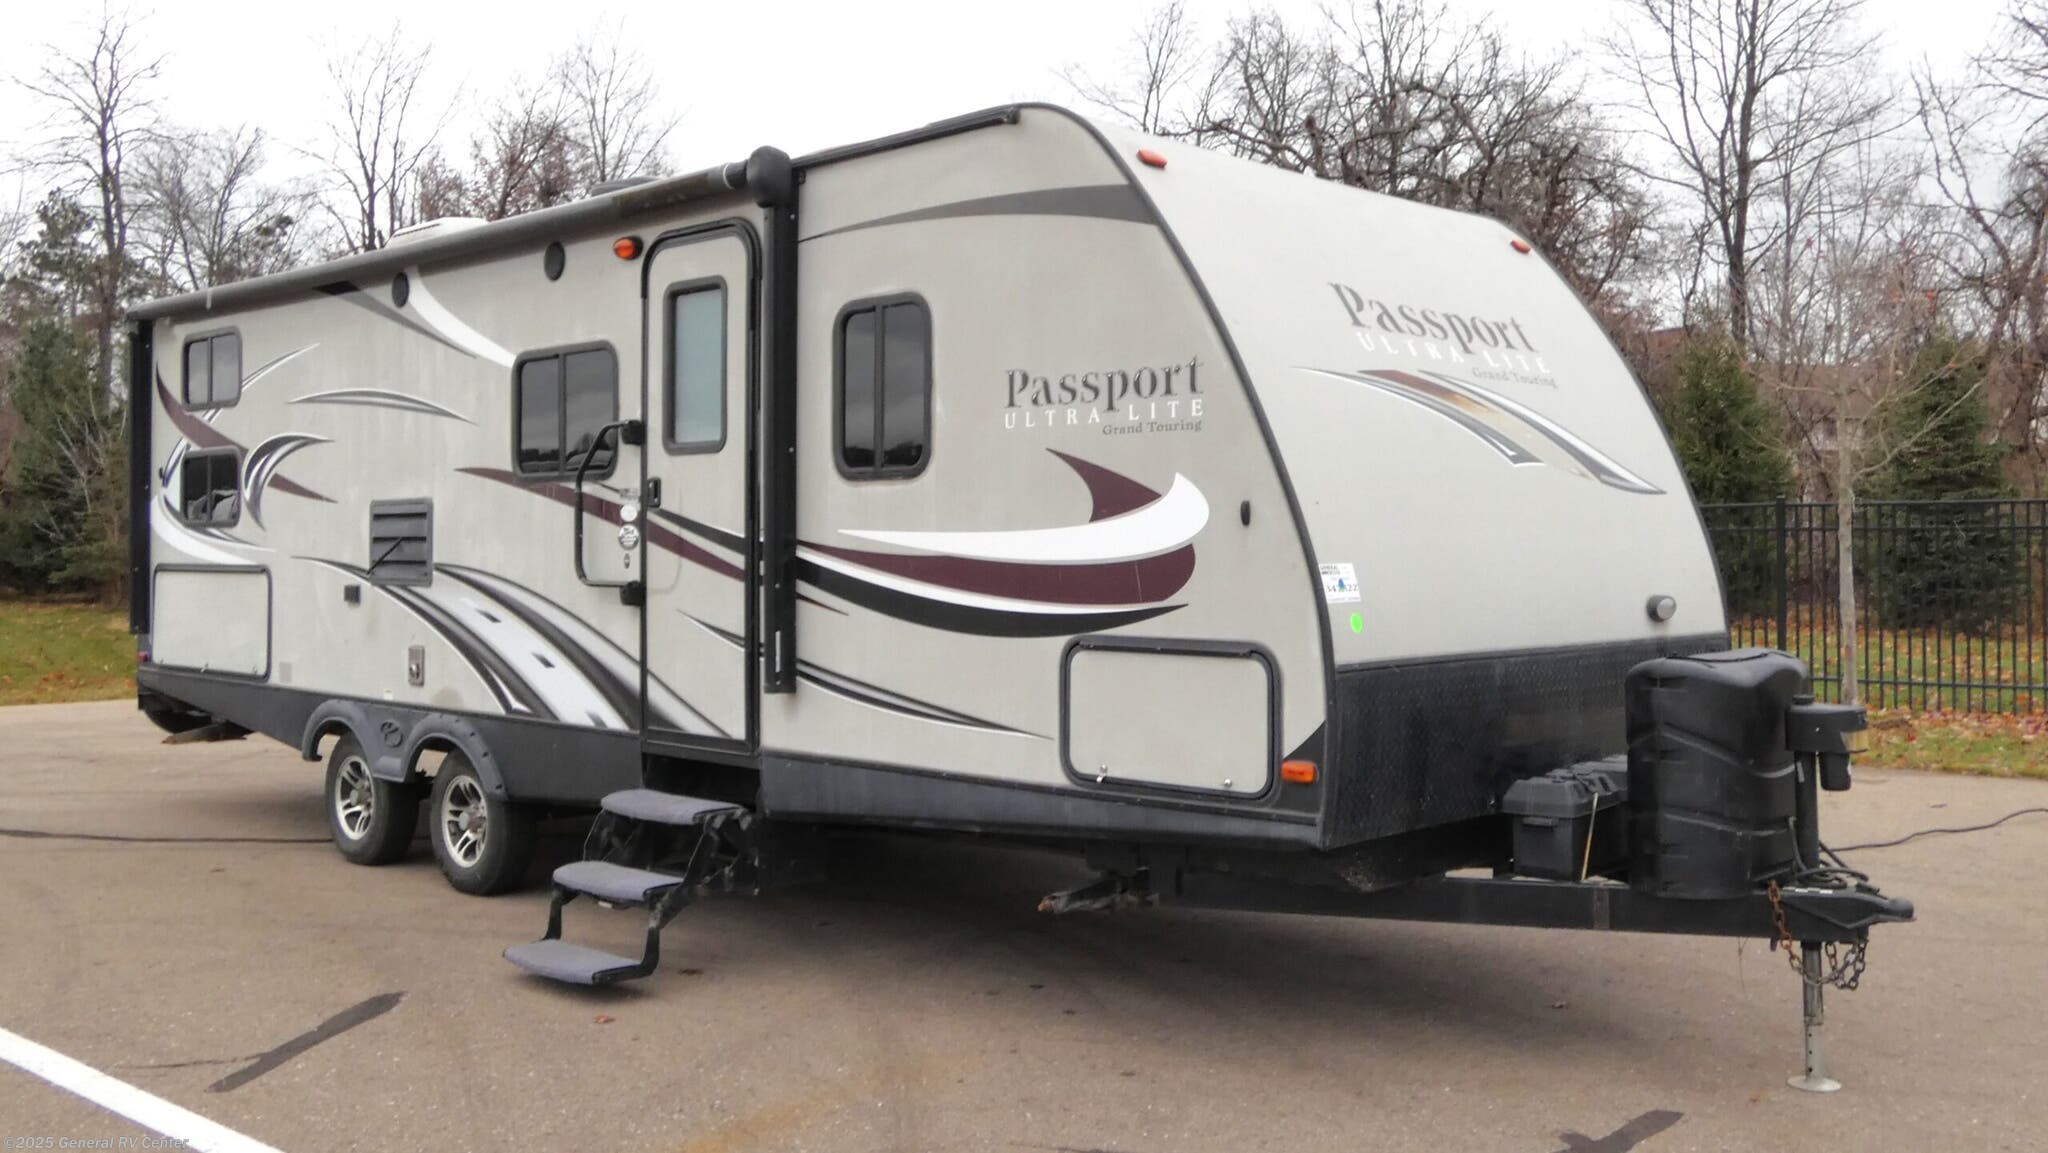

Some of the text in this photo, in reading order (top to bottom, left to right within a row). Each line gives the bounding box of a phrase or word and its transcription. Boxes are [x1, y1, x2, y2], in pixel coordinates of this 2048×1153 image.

[1328, 281, 1539, 355] Passport
[1356, 331, 1551, 374] ULTRA LITE
[1005, 354, 1205, 413] Passport
[1004, 399, 1204, 429] ULTRA LITE
[1102, 418, 1203, 436] Grand Touring
